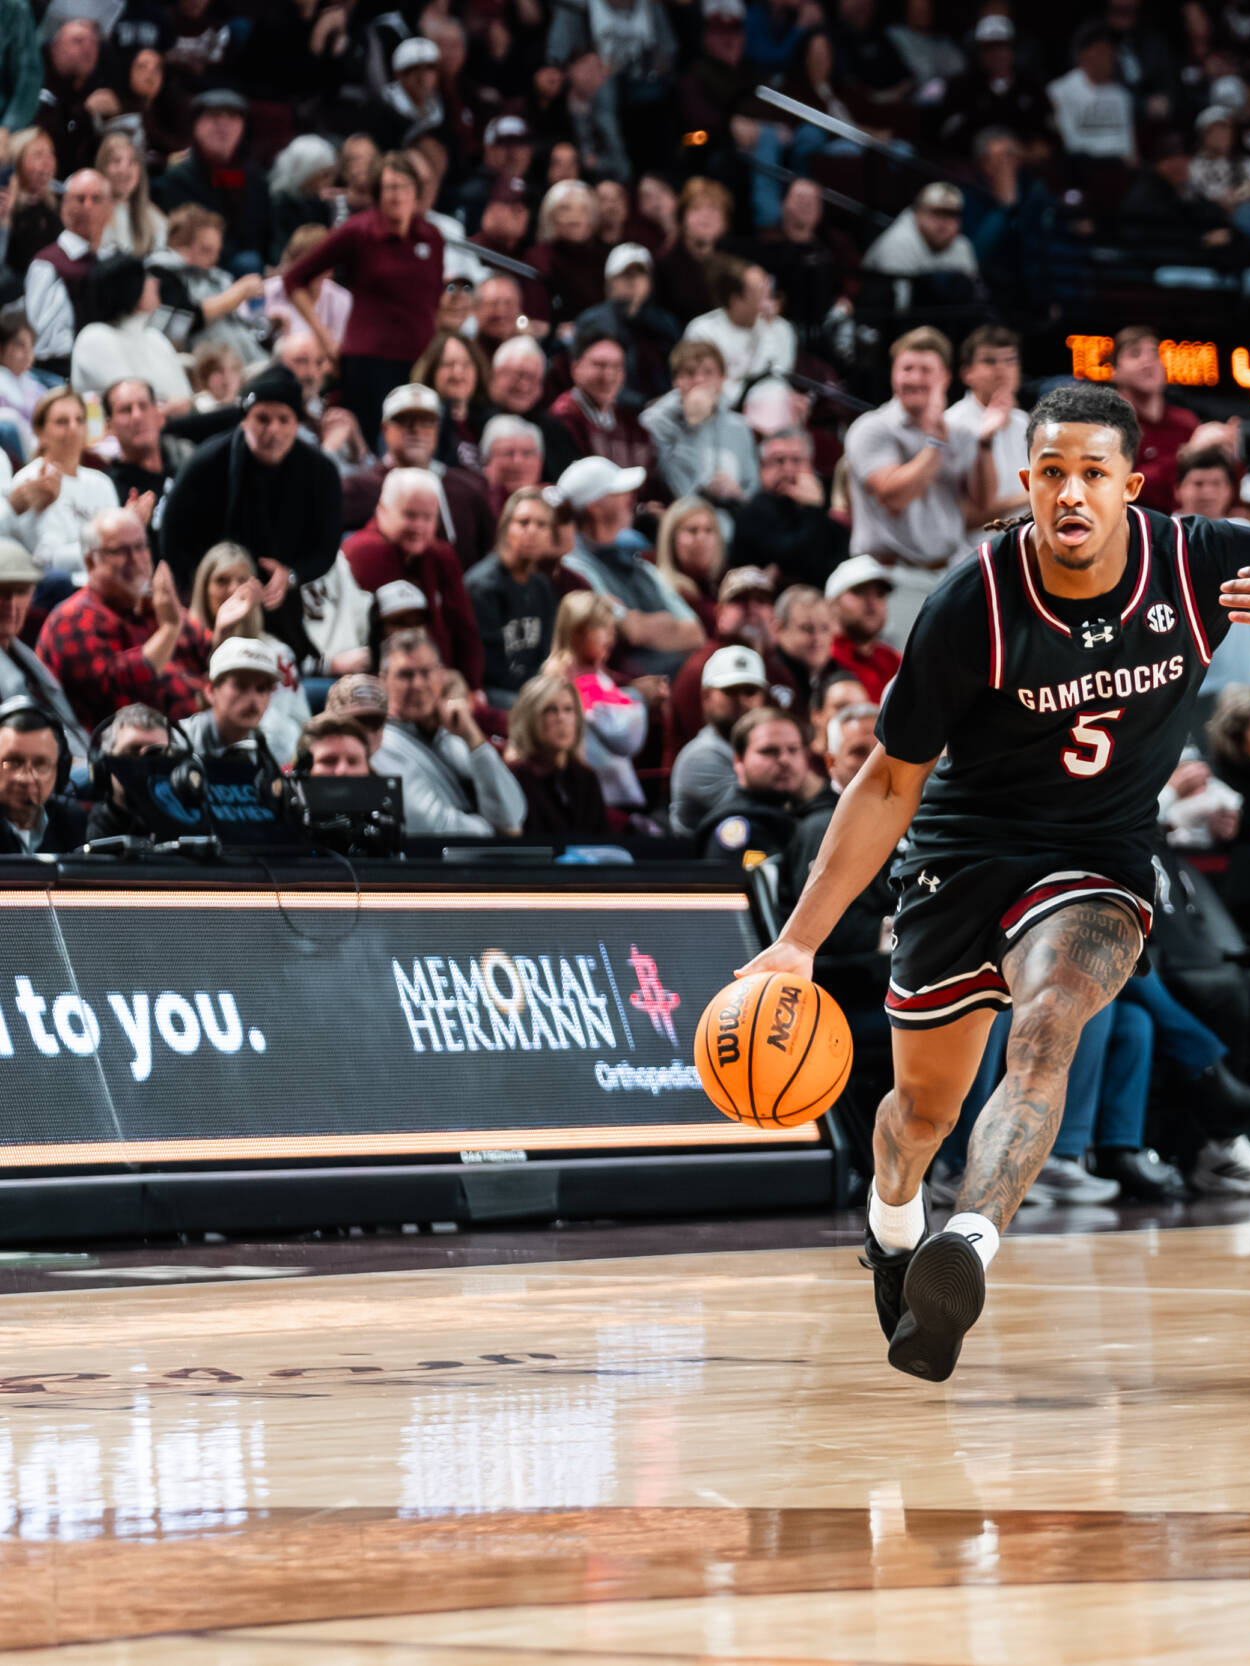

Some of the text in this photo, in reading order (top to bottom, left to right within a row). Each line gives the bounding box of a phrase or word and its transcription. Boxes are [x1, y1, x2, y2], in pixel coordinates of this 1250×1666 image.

[1146, 603, 1177, 633] SEC
[1017, 654, 1185, 714] GAMECOCKS
[1060, 707, 1126, 780] 5
[391, 949, 607, 1010] MEMORIAL
[15, 975, 101, 1057] to
[106, 990, 266, 1081] you.
[402, 998, 617, 1052] HERMANN
[766, 986, 802, 1052] NCAA
